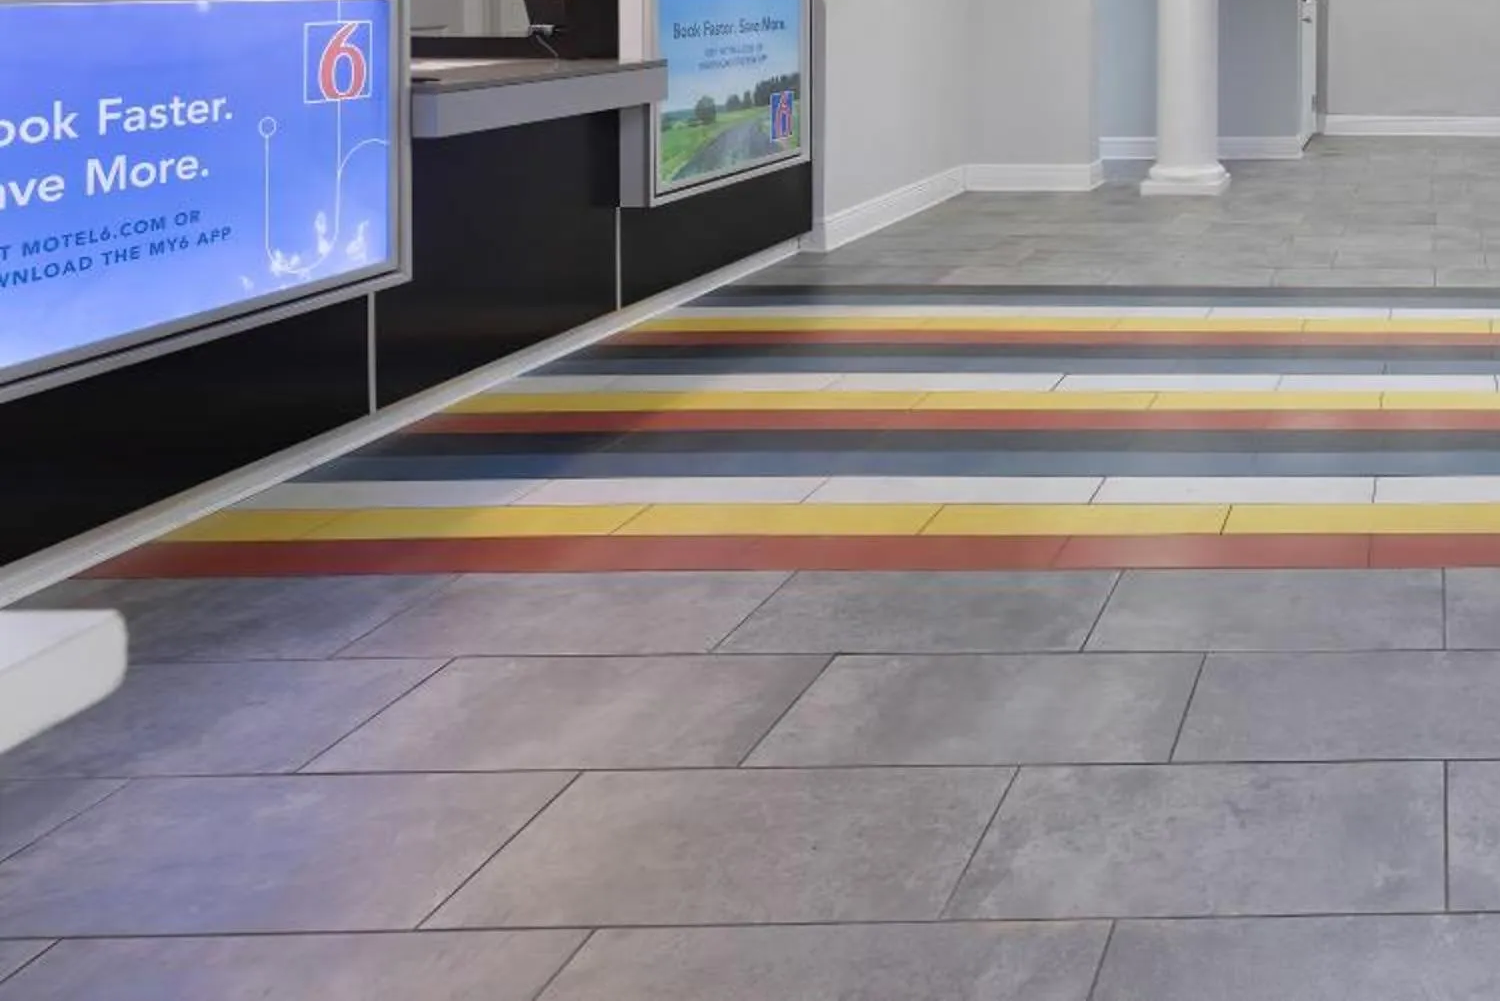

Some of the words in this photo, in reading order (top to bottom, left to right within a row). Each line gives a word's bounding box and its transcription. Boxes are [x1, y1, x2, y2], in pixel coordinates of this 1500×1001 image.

[673, 21, 701, 40] Book
[318, 20, 368, 101] 6
[98, 95, 233, 136] Faster.
[85, 154, 209, 197] More.
[22, 216, 166, 258] MOTEL6.COM
[174, 210, 202, 227] OR
[100, 245, 142, 267] THE
[149, 235, 189, 257] MY6
[197, 226, 232, 247] APP
